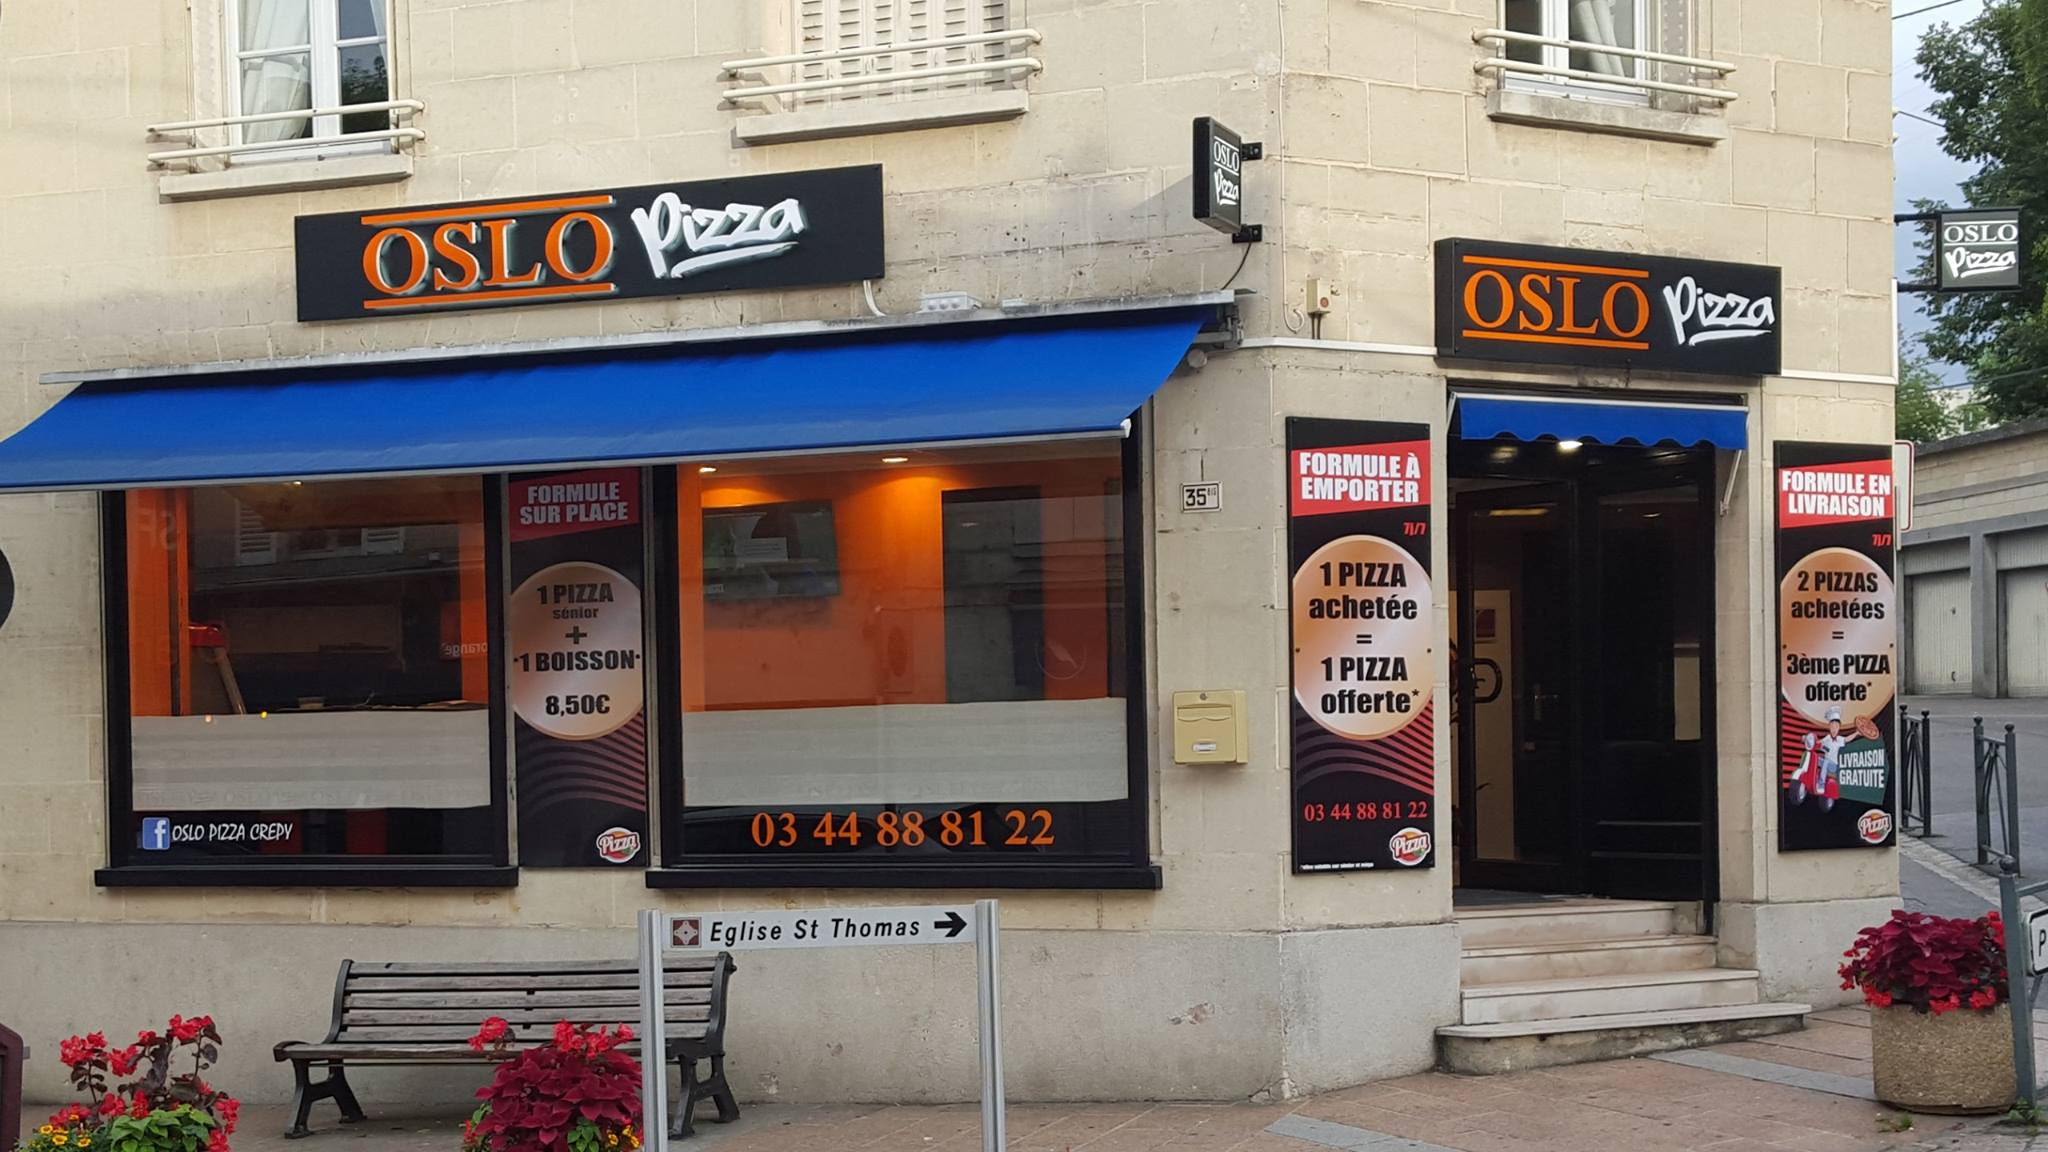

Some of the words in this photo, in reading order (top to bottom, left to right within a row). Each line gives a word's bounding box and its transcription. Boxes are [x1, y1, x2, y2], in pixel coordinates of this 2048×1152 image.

[1213, 140, 1239, 172] OSLO
[1213, 167, 1239, 205] Pizza
[363, 211, 616, 295] OSLO
[631, 191, 804, 280] Pizza
[1944, 223, 2018, 242] OSLO
[1944, 246, 2016, 278] Pizza
[1463, 269, 1650, 338] OSLO
[1662, 275, 1776, 346] Pizza
[1299, 452, 1401, 478] FORMULE
[1405, 452, 1421, 478] À
[527, 482, 620, 504] FORMULE
[1302, 477, 1420, 503] EMPORTER
[1782, 470, 1865, 494] FORMULE
[1869, 474, 1891, 495] EN
[1185, 488, 1207, 506] 35
[1788, 493, 1886, 517] LIVRAISON
[520, 505, 561, 525] SUR
[566, 502, 629, 522] PLACE
[1319, 562, 1332, 587] 1
[1339, 562, 1407, 588] PIZZA
[1797, 571, 1810, 592] 2
[1814, 571, 1879, 593] PIZZAS
[537, 585, 549, 605] 1
[553, 583, 615, 604] PIZZA
[1309, 594, 1418, 620] achetée
[1791, 597, 1885, 620] achetées
[519, 652, 530, 673] 1
[535, 649, 635, 672] BOISSON
[1320, 656, 1333, 682] 1
[1340, 656, 1409, 682] PIZZA
[1786, 652, 1841, 675] 3ème
[1843, 653, 1891, 675] PIZZA
[545, 694, 611, 717] 8,50€
[1839, 748, 1885, 769] LIVRAISON
[1839, 769, 1885, 789] GRATUITE
[1304, 803, 1325, 822] 03
[1330, 803, 1352, 820] 44
[1356, 802, 1378, 820] 88
[1382, 802, 1402, 819] 81
[1407, 801, 1428, 819] 22
[172, 823, 204, 842] OSLO
[208, 823, 246, 842] PIZZA
[250, 823, 293, 841] CREPY
[751, 811, 798, 847] 03
[813, 811, 862, 846] 44
[876, 810, 925, 847] 88
[940, 810, 987, 847] 81
[1004, 809, 1056, 846] 22
[1859, 815, 1890, 836] Pizza
[599, 835, 638, 855] Pizza
[1392, 834, 1428, 858] Pizza
[710, 921, 783, 947] Eglise
[794, 919, 819, 940] St
[831, 917, 921, 939] Thomas
